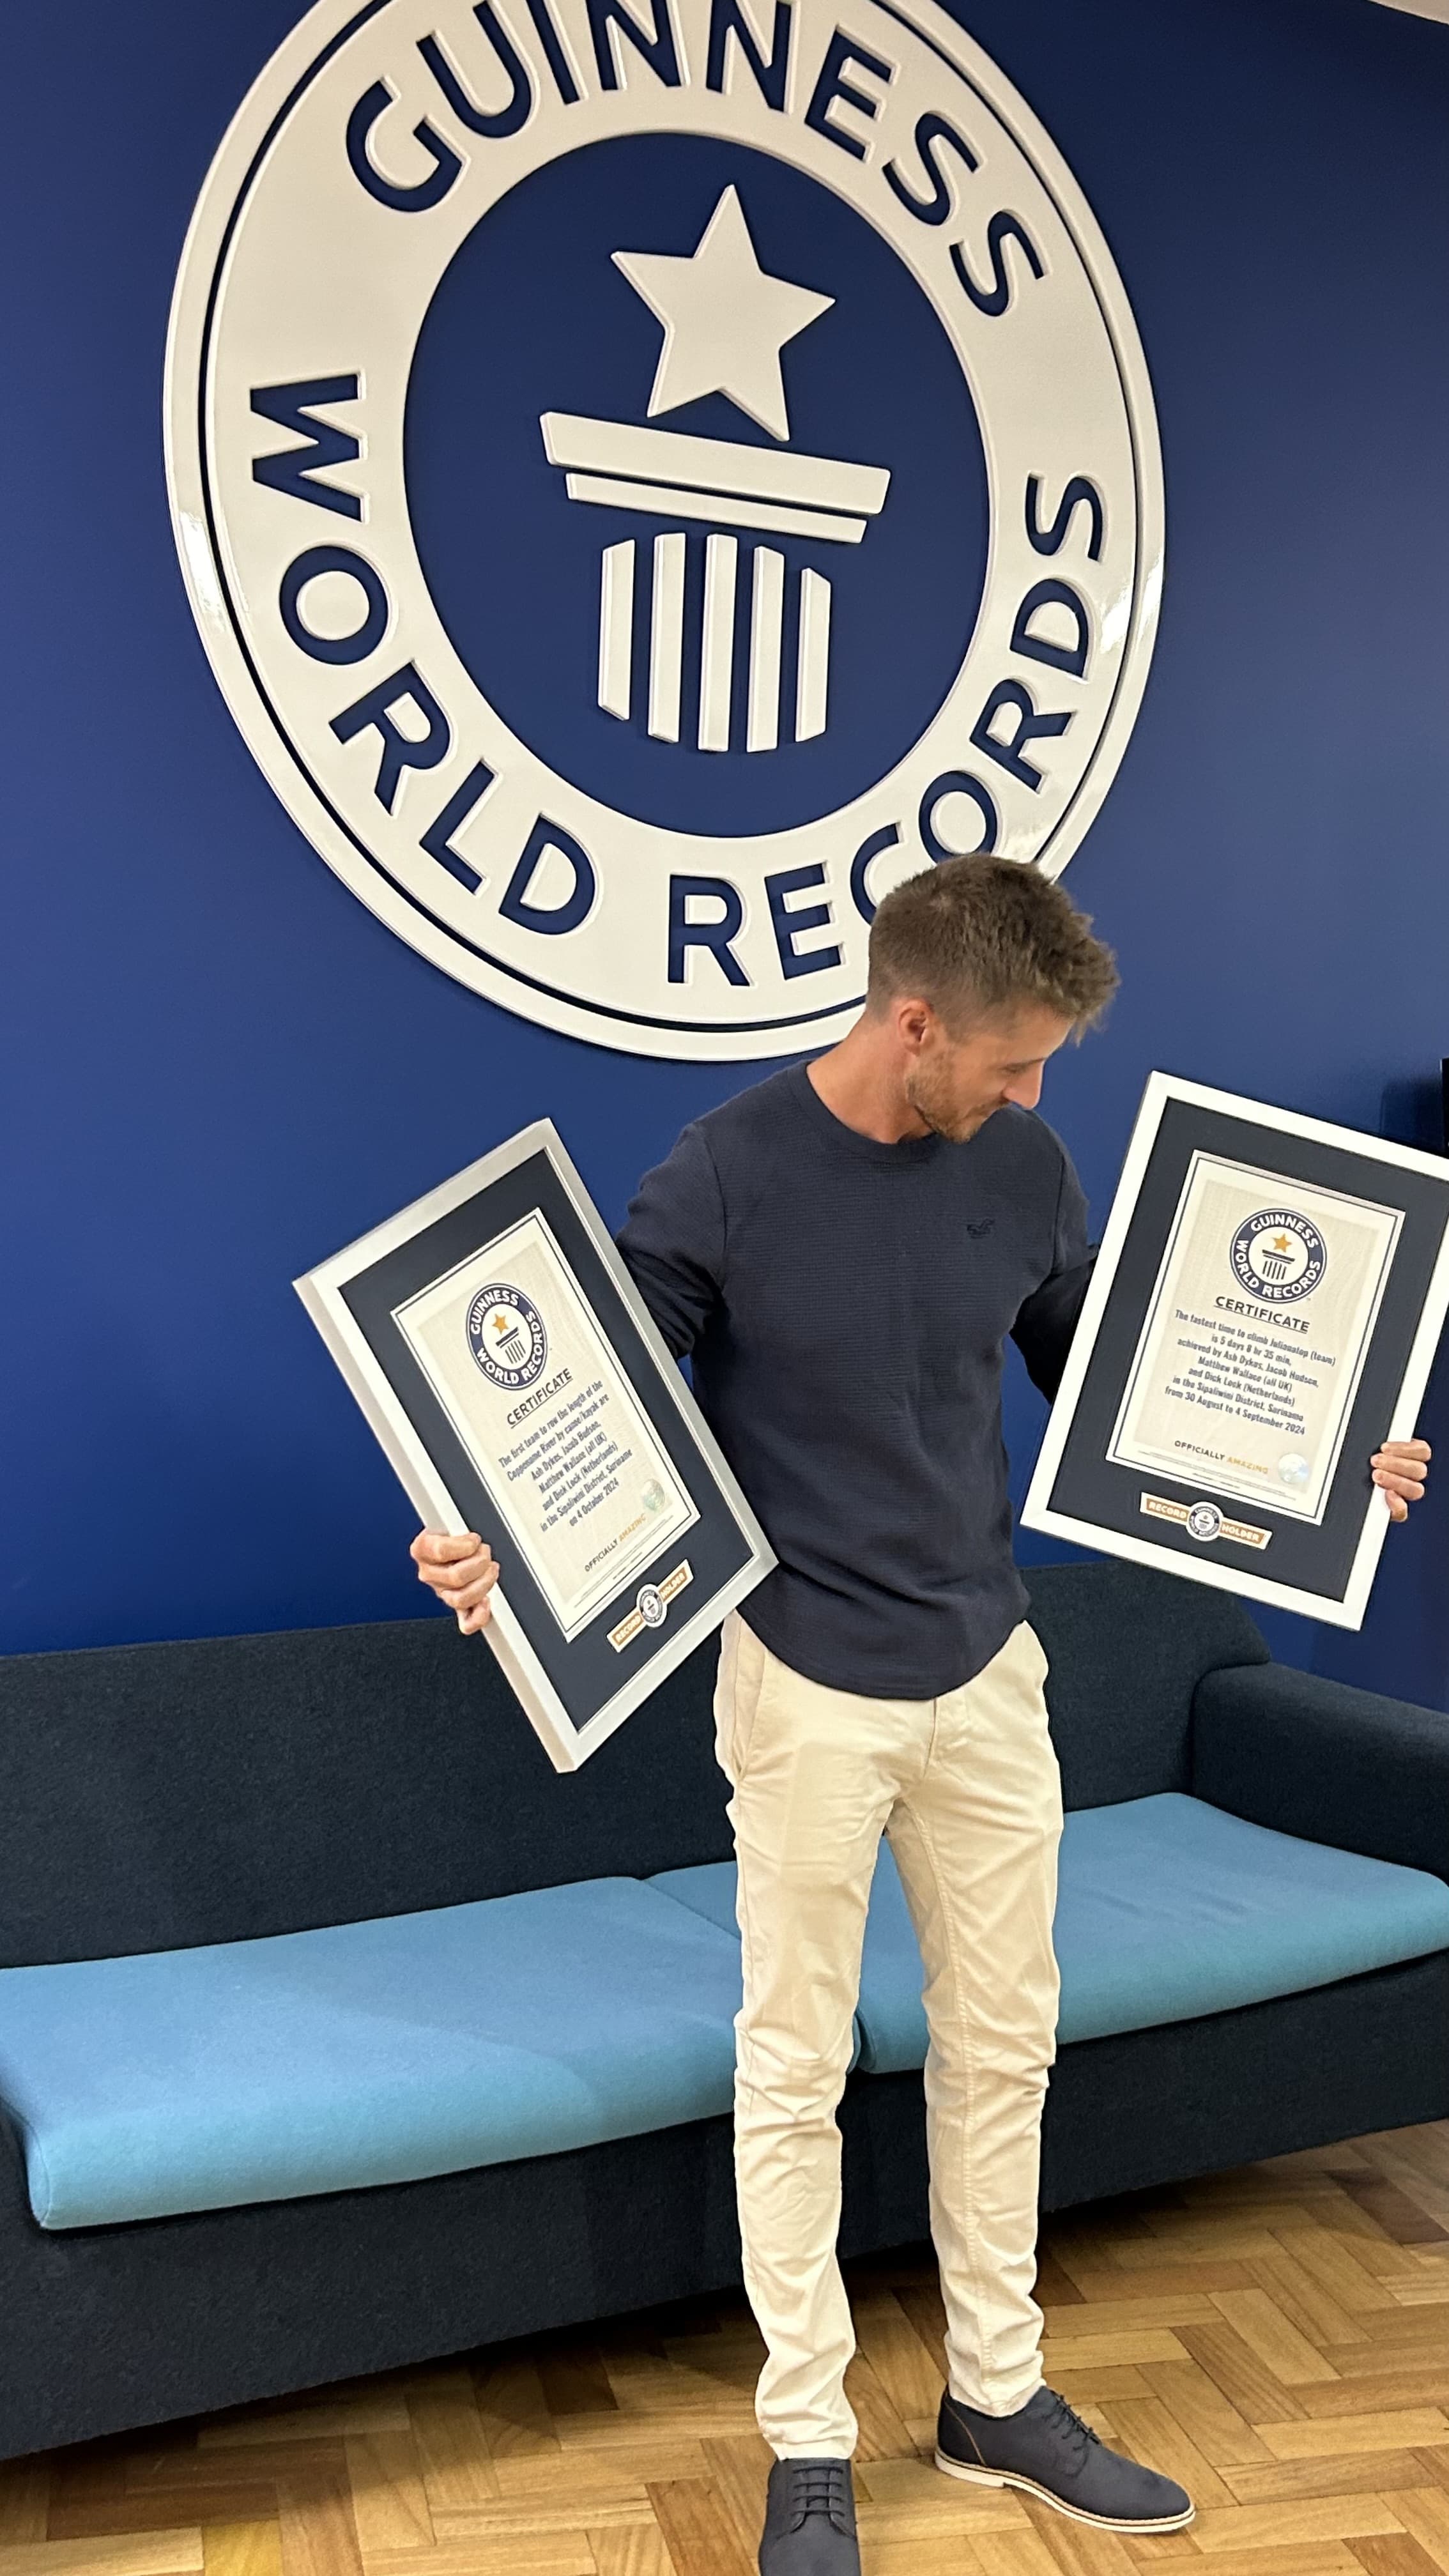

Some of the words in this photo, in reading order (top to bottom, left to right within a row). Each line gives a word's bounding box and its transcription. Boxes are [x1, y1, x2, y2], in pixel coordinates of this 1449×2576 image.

[346, 0, 1048, 318] GUINNESS
[249, 372, 597, 937] WORLD
[1250, 1214, 1319, 1248] GUINNESS
[1236, 1239, 1259, 1289] WORLD
[1262, 1261, 1320, 1298] RECORDS
[471, 1290, 519, 1334] GUINNESS
[1216, 1296, 1310, 1332] CERTIFICATE
[476, 1347, 519, 1384] WORLD
[521, 1311, 545, 1382] RECORDS
[1176, 1309, 1188, 1321] The
[1190, 1314, 1216, 1329] fastest
[1218, 1324, 1236, 1335] time
[1238, 1329, 1245, 1338] to
[1247, 1333, 1268, 1344] climb
[1310, 1351, 1336, 1367] (team)
[1177, 1339, 1211, 1353] achieved
[1213, 1347, 1222, 1358] by
[1223, 1351, 1238, 1361] Ash
[1265, 1363, 1287, 1377] Jacob
[1211, 1334, 1218, 1343] is
[1220, 1336, 1225, 1345] 5
[1227, 1339, 1244, 1351] days
[1246, 1344, 1252, 1353] 8
[1254, 1346, 1262, 1356] hr
[1264, 1349, 1274, 1360] 35
[1276, 1355, 1291, 1366] min,
[1173, 1376, 1181, 1384] in
[1183, 1379, 1195, 1388] the
[1188, 1368, 1203, 1377] and
[1204, 1371, 1221, 1383] Dick
[1198, 1356, 1230, 1372] Matthew
[1233, 1367, 1262, 1382] Wallace
[507, 1368, 572, 1425] CERTIFICATE
[1165, 1386, 1183, 1399] from
[1185, 1392, 1195, 1402] 30
[1197, 1395, 1223, 1411] August
[1225, 1405, 1233, 1413] to
[1243, 1409, 1283, 1428] September
[1285, 1422, 1305, 1435] 2024
[498, 1455, 512, 1468] The
[510, 1443, 525, 1459] first
[524, 1432, 540, 1448] team
[539, 1426, 547, 1435] to
[547, 1417, 558, 1429] row
[557, 1409, 569, 1420] the
[567, 1393, 587, 1412] length
[586, 1386, 593, 1397] of
[592, 1381, 602, 1392] the
[539, 1437, 556, 1453] River
[555, 1431, 565, 1441] by
[599, 1394, 609, 1406] are
[531, 1467, 544, 1480] Ash
[562, 1437, 579, 1455] Jacob
[539, 1470, 564, 1494] Matthew
[563, 1452, 586, 1472] Wallace
[1175, 1441, 1225, 1460] OFFICIALLY
[1227, 1457, 1268, 1474] AMAZING
[542, 1495, 554, 1511] and
[553, 1485, 567, 1501] Dick
[569, 1516, 578, 1526] on
[581, 1492, 604, 1514] October
[603, 1477, 618, 1496] 2024
[540, 1523, 548, 1531] in
[547, 1514, 558, 1526] the
[585, 1538, 618, 1572] OFFICIALLY
[619, 1514, 645, 1542] AMAZING
[1148, 1501, 1186, 1519] RECORD
[1222, 1523, 1259, 1542] HOLDER
[616, 1616, 641, 1641] RECORD
[659, 1573, 685, 1600] HOLDER
